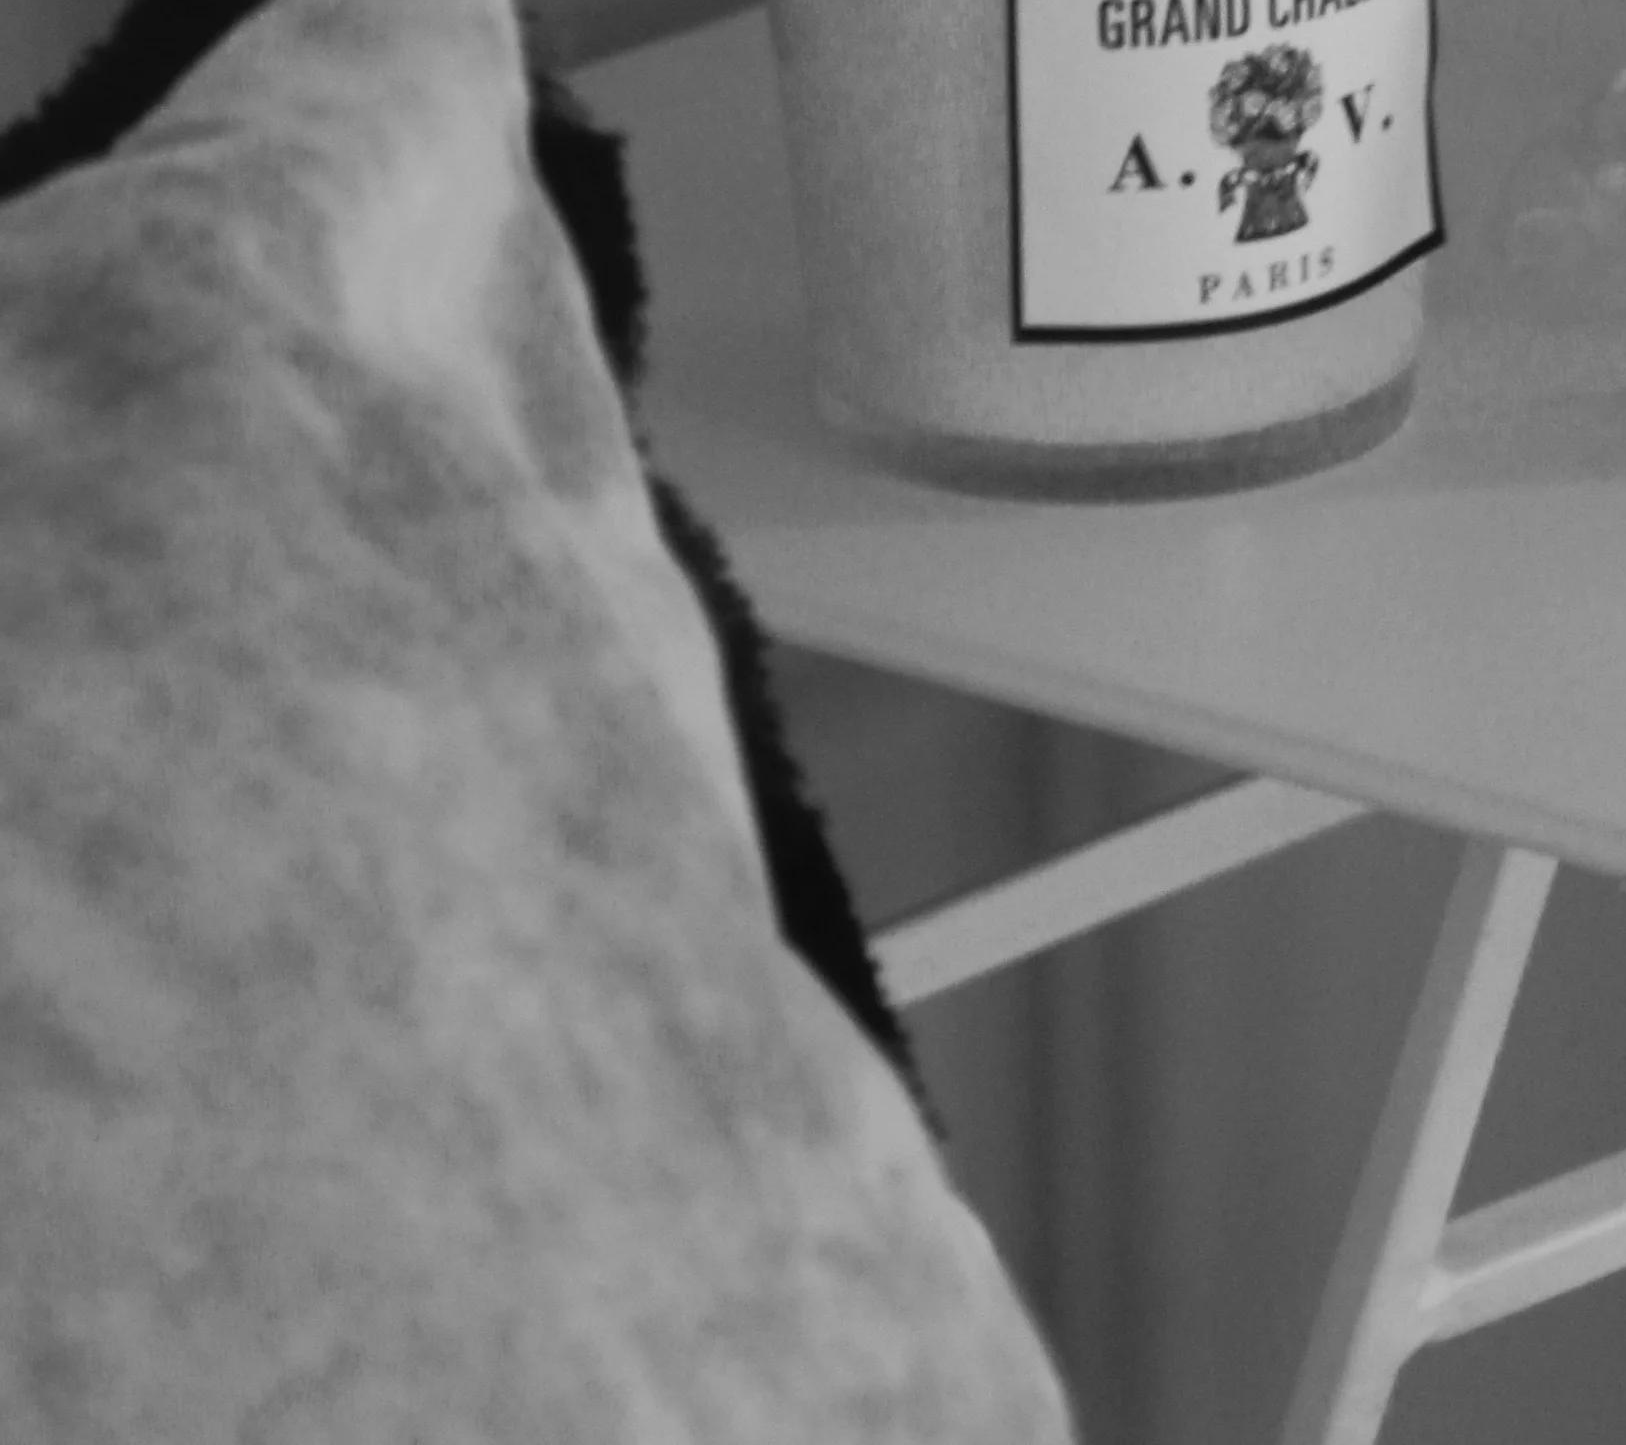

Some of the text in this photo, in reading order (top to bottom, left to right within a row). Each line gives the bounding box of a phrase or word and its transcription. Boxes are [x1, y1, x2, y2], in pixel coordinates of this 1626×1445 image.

[1106, 83, 1395, 192] A. V.
[1198, 245, 1335, 305] PARIS
